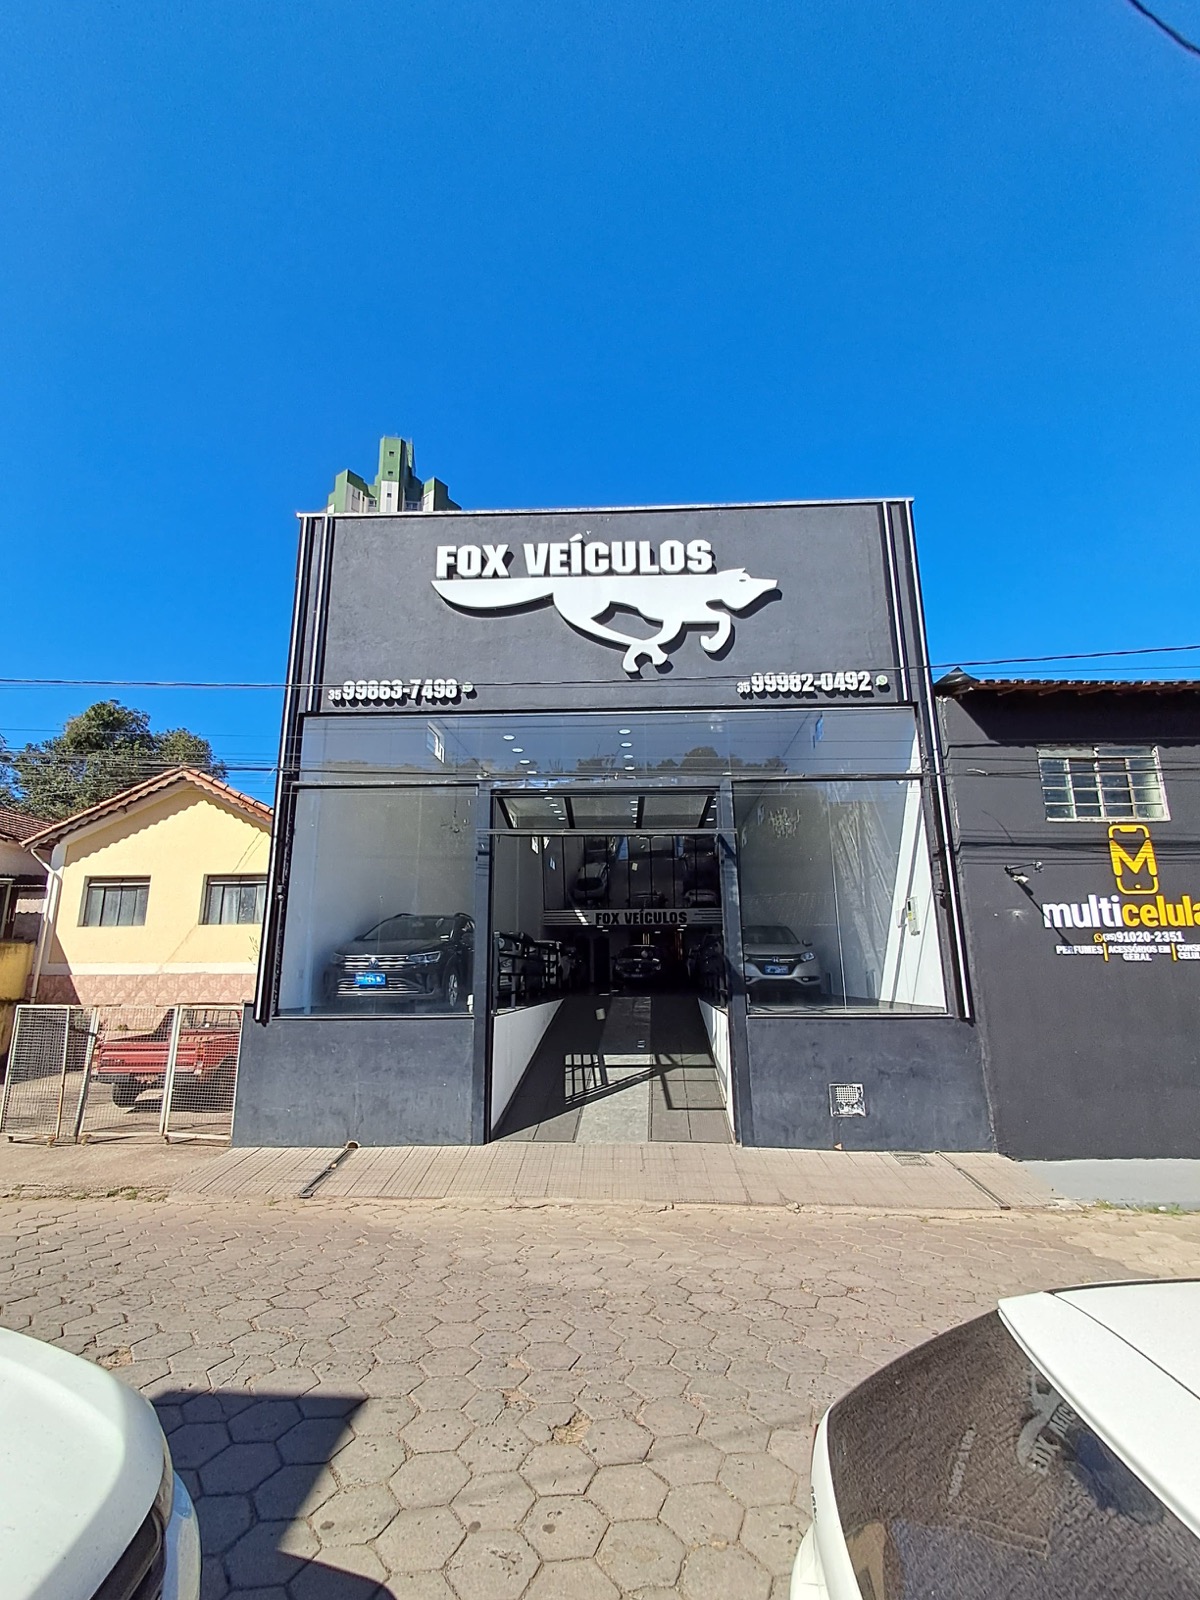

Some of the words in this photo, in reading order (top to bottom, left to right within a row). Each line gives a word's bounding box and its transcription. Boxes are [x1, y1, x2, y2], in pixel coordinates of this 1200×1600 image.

[436, 544, 509, 579] FOX
[523, 532, 712, 577] VEÍCULOS
[737, 681, 750, 693] 35
[751, 671, 872, 693] 99982-0492
[328, 689, 342, 701] 35
[595, 912, 619, 925] FOX
[624, 909, 687, 925] VEÍCULOS
[1056, 945, 1103, 955] PERFUMES
[1108, 943, 1157, 954] ACESSÓRIOS
[1158, 945, 1171, 954] EM
[1122, 952, 1152, 962] GERAL
